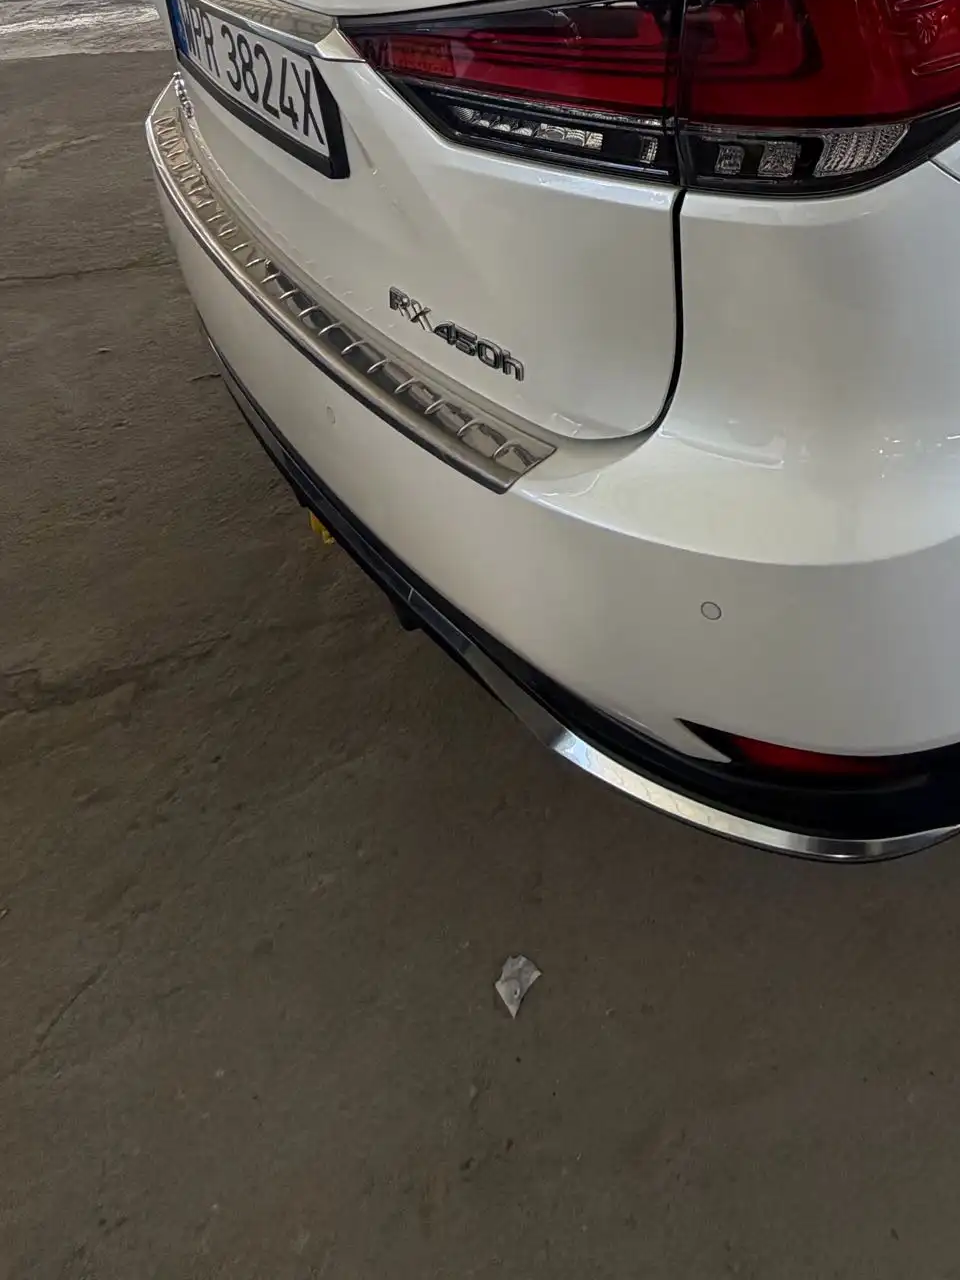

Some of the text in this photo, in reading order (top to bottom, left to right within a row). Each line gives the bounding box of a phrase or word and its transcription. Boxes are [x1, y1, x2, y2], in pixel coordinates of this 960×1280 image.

[221, 24, 325, 145] 3824X
[389, 286, 524, 381] RX 450h
